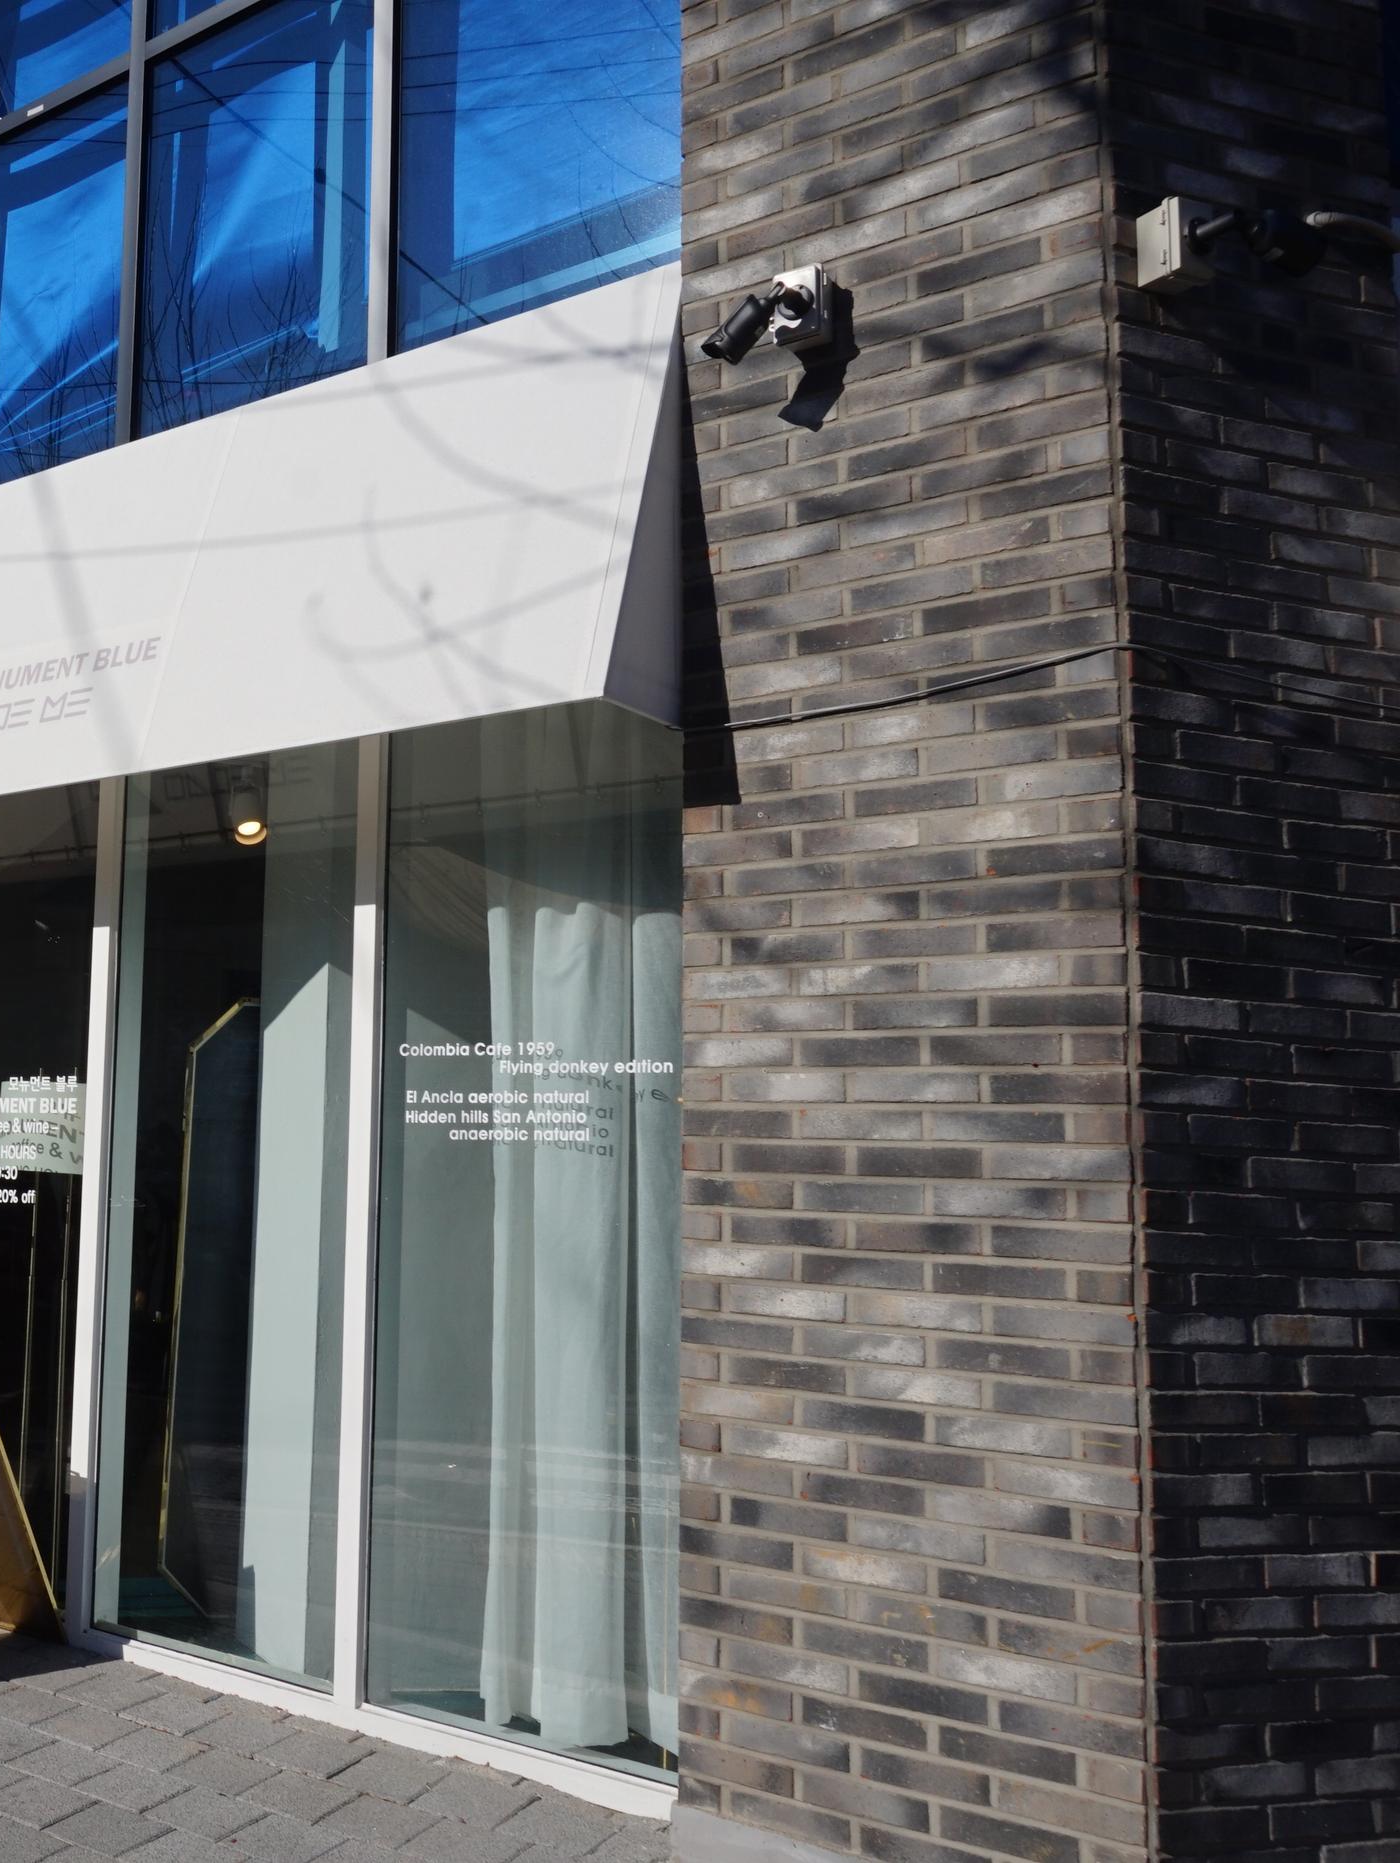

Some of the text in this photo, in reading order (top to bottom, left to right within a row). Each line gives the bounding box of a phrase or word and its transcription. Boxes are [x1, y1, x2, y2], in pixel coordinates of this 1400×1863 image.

[92, 636, 162, 672] BLUE
[399, 1042, 555, 1057] Colombia Cafe 1959
[499, 1059, 674, 1076] Flying donkey edition
[8, 1075, 78, 1093] 모뉴먼트 블루
[406, 1090, 590, 1104] El Ancla aerobic natural
[39, 1097, 78, 1114] BLUE
[405, 1110, 587, 1124] Hidden hills San Antonio
[12, 1118, 24, 1133] &
[449, 1127, 590, 1141] anaerobic natural
[0, 1145, 37, 1160] HOURS
[21, 1190, 36, 1204] off
